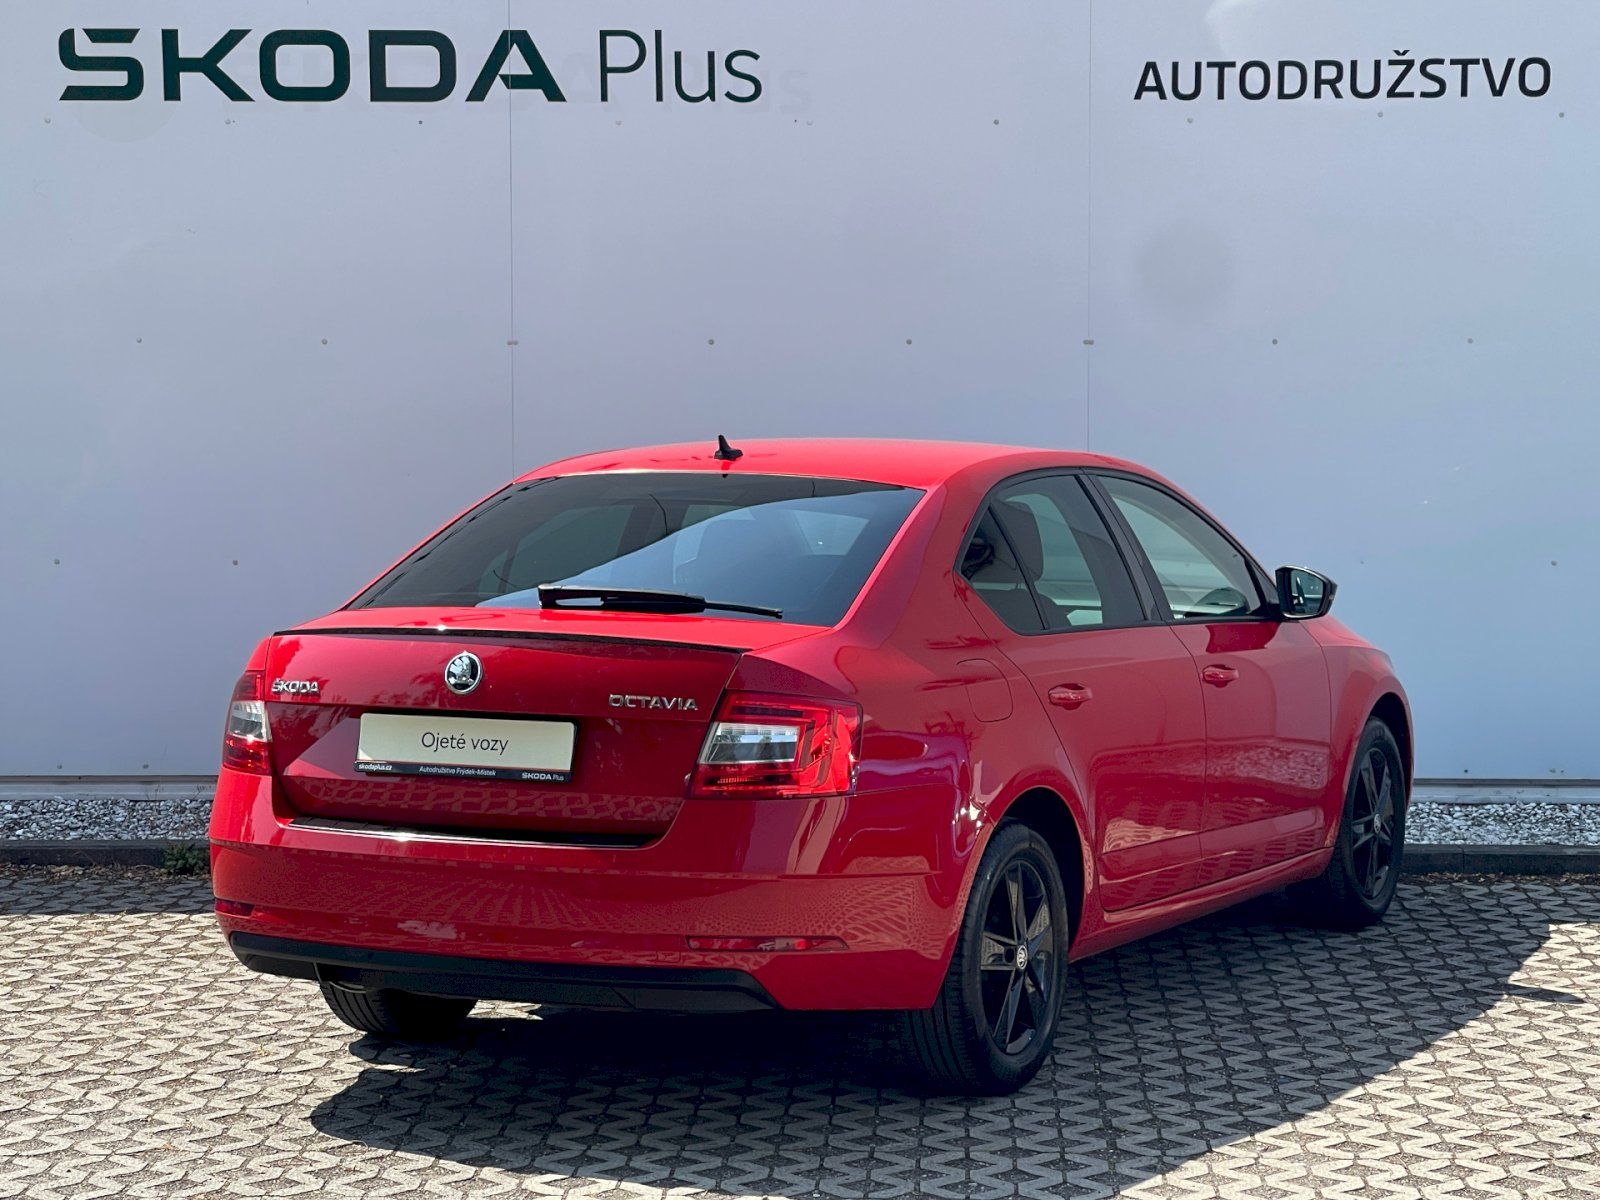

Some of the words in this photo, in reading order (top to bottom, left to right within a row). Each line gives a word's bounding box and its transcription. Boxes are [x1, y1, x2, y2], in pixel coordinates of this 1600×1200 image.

[599, 28, 763, 103] Plus
[1134, 50, 1551, 100] AUTODRUŽSTVO
[608, 694, 699, 711] OCTAVIA
[421, 731, 466, 752] Ojeté
[471, 737, 509, 755] vozy
[358, 763, 393, 772] skodaplus.cz
[552, 773, 564, 781] Plus
